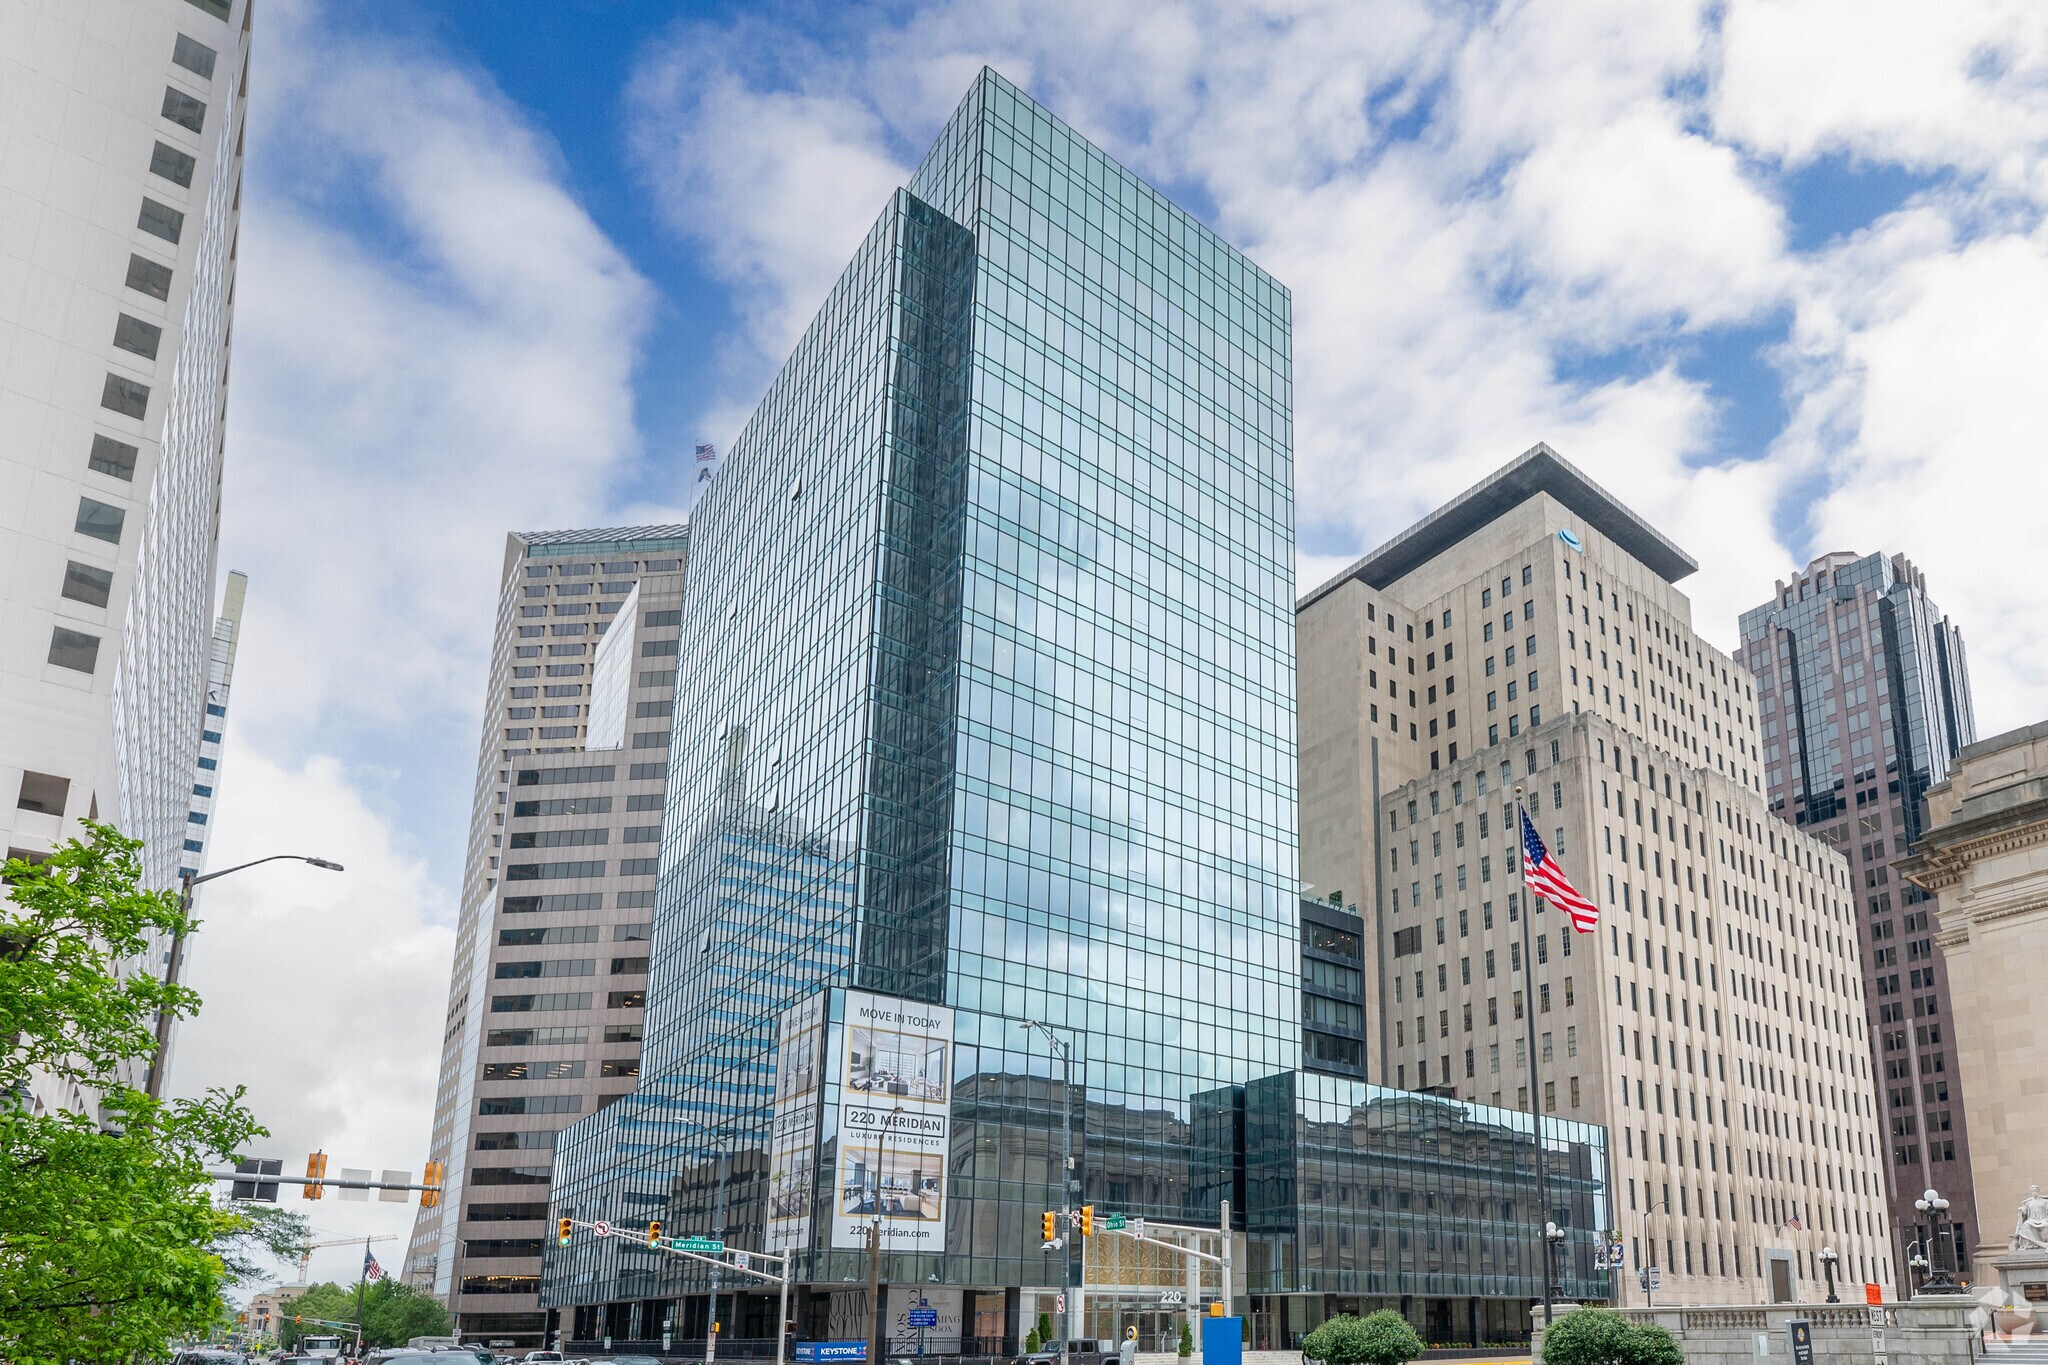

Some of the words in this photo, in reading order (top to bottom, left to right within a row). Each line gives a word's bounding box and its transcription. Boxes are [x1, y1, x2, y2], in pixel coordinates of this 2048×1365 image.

[859, 1007, 892, 1022] MOVE
[894, 1013, 905, 1024] IN
[907, 1015, 942, 1029] TODAY
[850, 1110, 876, 1125] 220
[880, 1115, 941, 1132] MERIDIAN
[888, 1135, 940, 1147] RESIDENCES
[1106, 1221, 1118, 1229] Ohio
[849, 1225, 930, 1239] 220eridian.com
[1160, 1291, 1181, 1302] 220
[830, 1293, 869, 1317] COMIN
[820, 1347, 858, 1355] KEYSTONE
